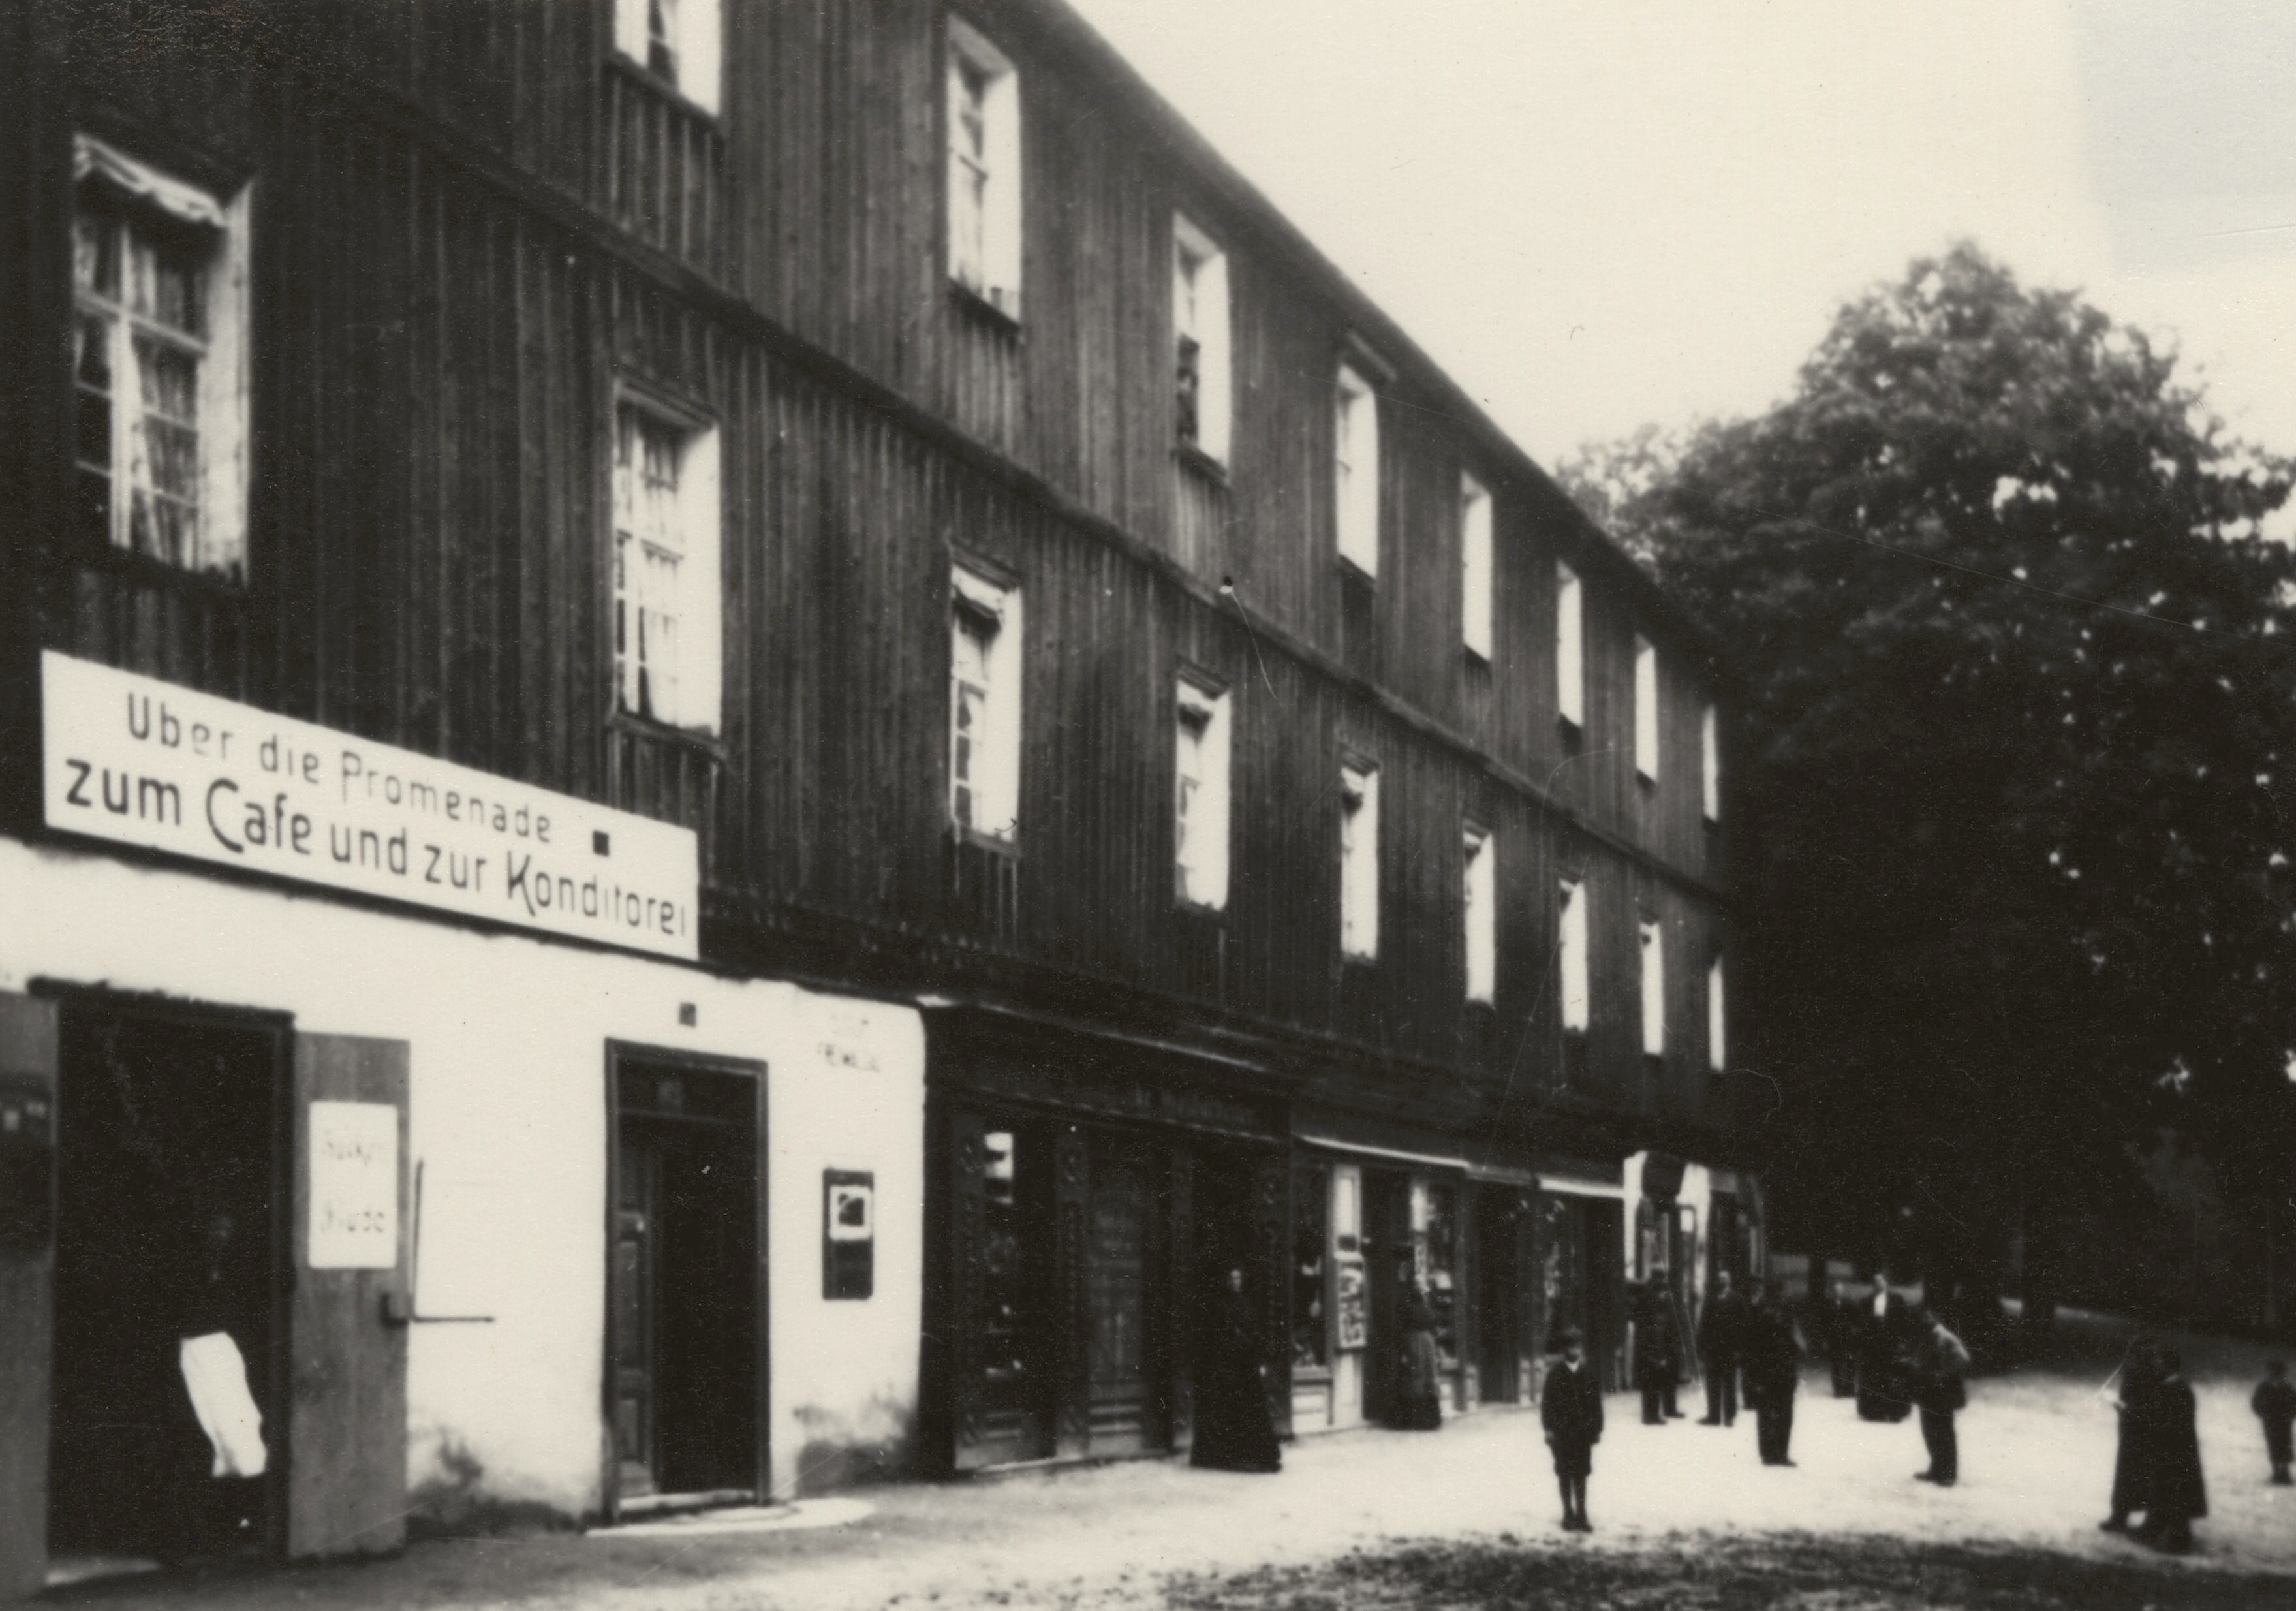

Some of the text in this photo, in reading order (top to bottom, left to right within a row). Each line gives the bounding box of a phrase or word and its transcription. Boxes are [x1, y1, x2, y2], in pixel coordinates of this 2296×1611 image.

[65, 758, 686, 937] zum Cafe und zur Konditorei
[259, 734, 320, 783] die
[341, 750, 550, 843] Promenade
